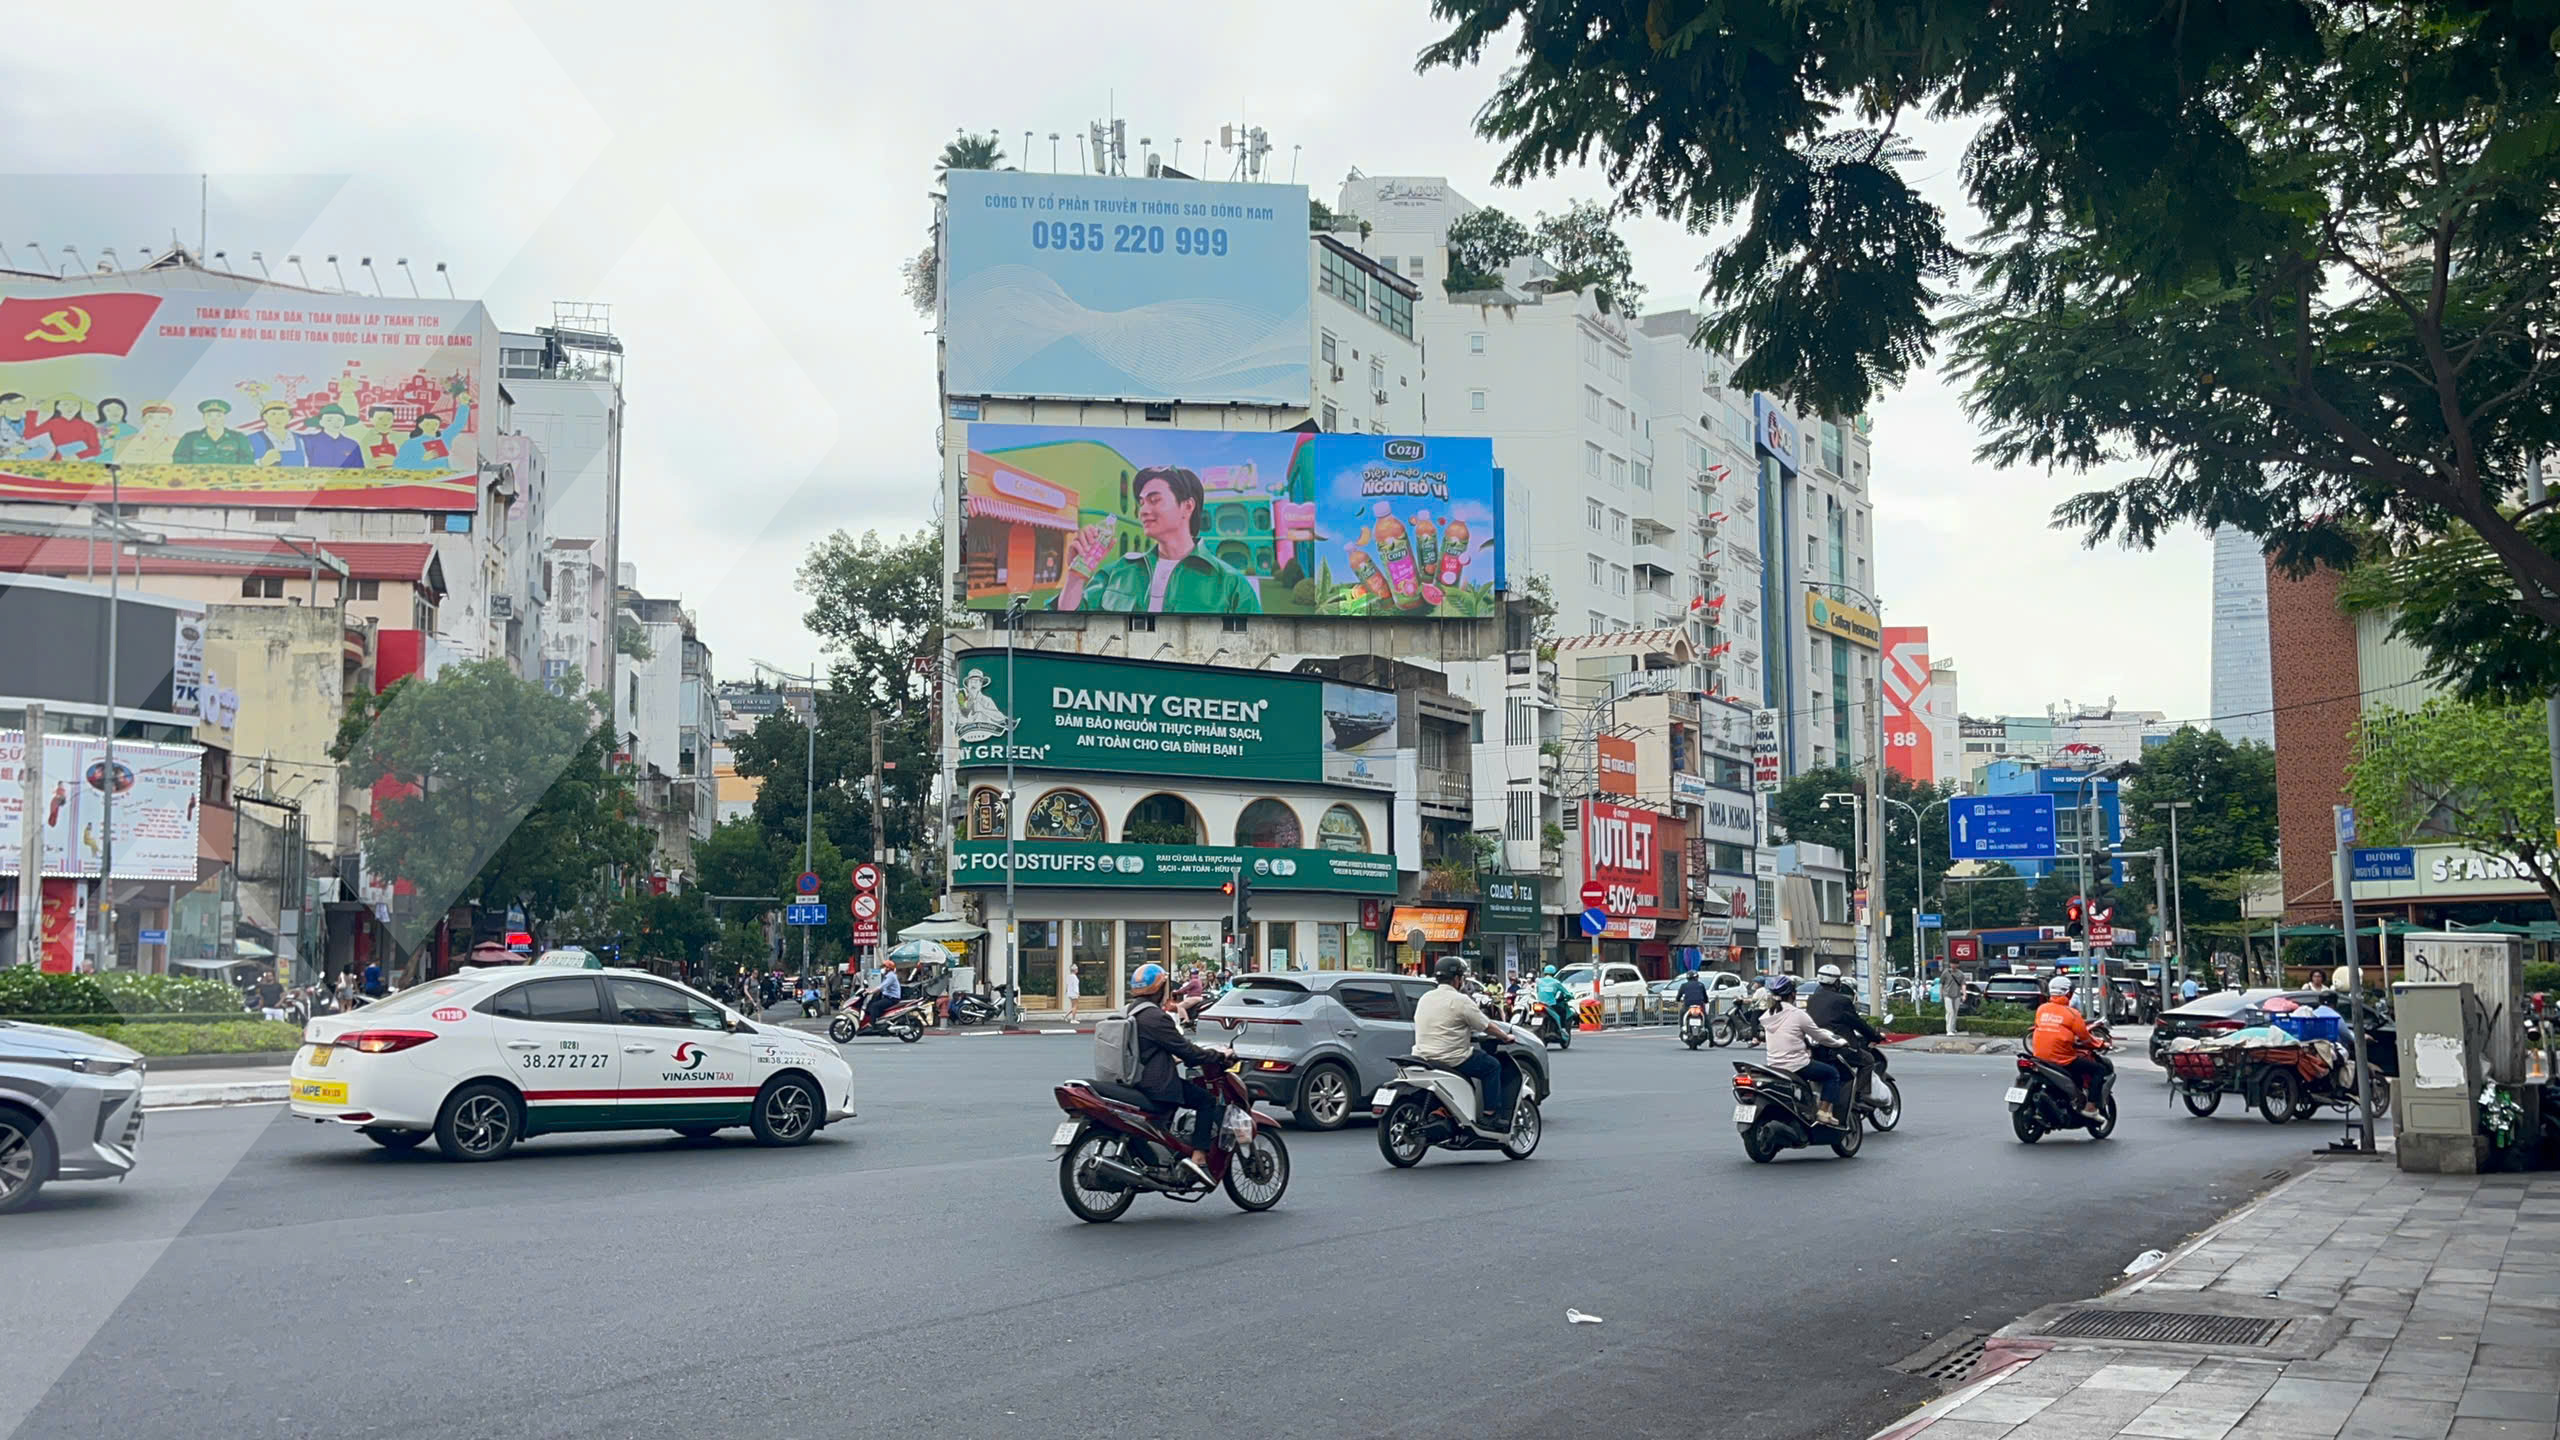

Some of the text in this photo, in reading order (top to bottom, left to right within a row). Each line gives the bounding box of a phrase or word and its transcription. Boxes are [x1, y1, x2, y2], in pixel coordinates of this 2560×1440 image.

[984, 194, 1018, 209] CÔNG
[1020, 196, 1036, 209] TY
[1141, 200, 1180, 216] THÔNG
[1183, 203, 1207, 217] SAO
[1246, 207, 1274, 221] NAM
[1032, 220, 1228, 257] 0935 220 999
[1387, 442, 1421, 459] Cozy
[1361, 480, 1405, 496] NGON
[1831, 611, 1879, 643] Cathay Insurance
[176, 685, 200, 701] 7K
[1052, 687, 1260, 723] DANNY GREEN
[1055, 713, 1083, 728] ĐẢM
[1085, 715, 1113, 730] BẢO
[1159, 722, 1192, 737] THỰC
[1229, 727, 1263, 742] SẠCH,
[1755, 730, 1775, 741] NHA
[1971, 728, 2004, 737] HOTEL
[1077, 734, 1095, 746] AN
[1097, 734, 1131, 749] TOÀN
[1132, 738, 1158, 751] CHO
[1160, 740, 1182, 753] GIA
[1183, 741, 1211, 755] ĐÌNH
[1212, 744, 1237, 758] BẠN
[1893, 731, 1917, 747] 88
[975, 744, 1045, 760] GREEN
[1754, 743, 1778, 753] KHOA
[1754, 754, 1778, 768] TÂM
[1755, 768, 1777, 782] ĐỨC
[1707, 801, 1751, 830] NHA KHOA
[1156, 854, 1171, 863] RAU
[2365, 852, 2401, 862] ĐƯỜNG
[1157, 864, 1177, 873] SẠCH
[1181, 865, 1191, 873] AN
[1192, 864, 1211, 873] TOÀN
[1490, 884, 1533, 901] CRANE TEA
[1608, 884, 1637, 915] 50%
[435, 1010, 464, 1020] 17139
[560, 1041, 579, 1050] (028)
[522, 1054, 609, 1068] 38.27 27 27
